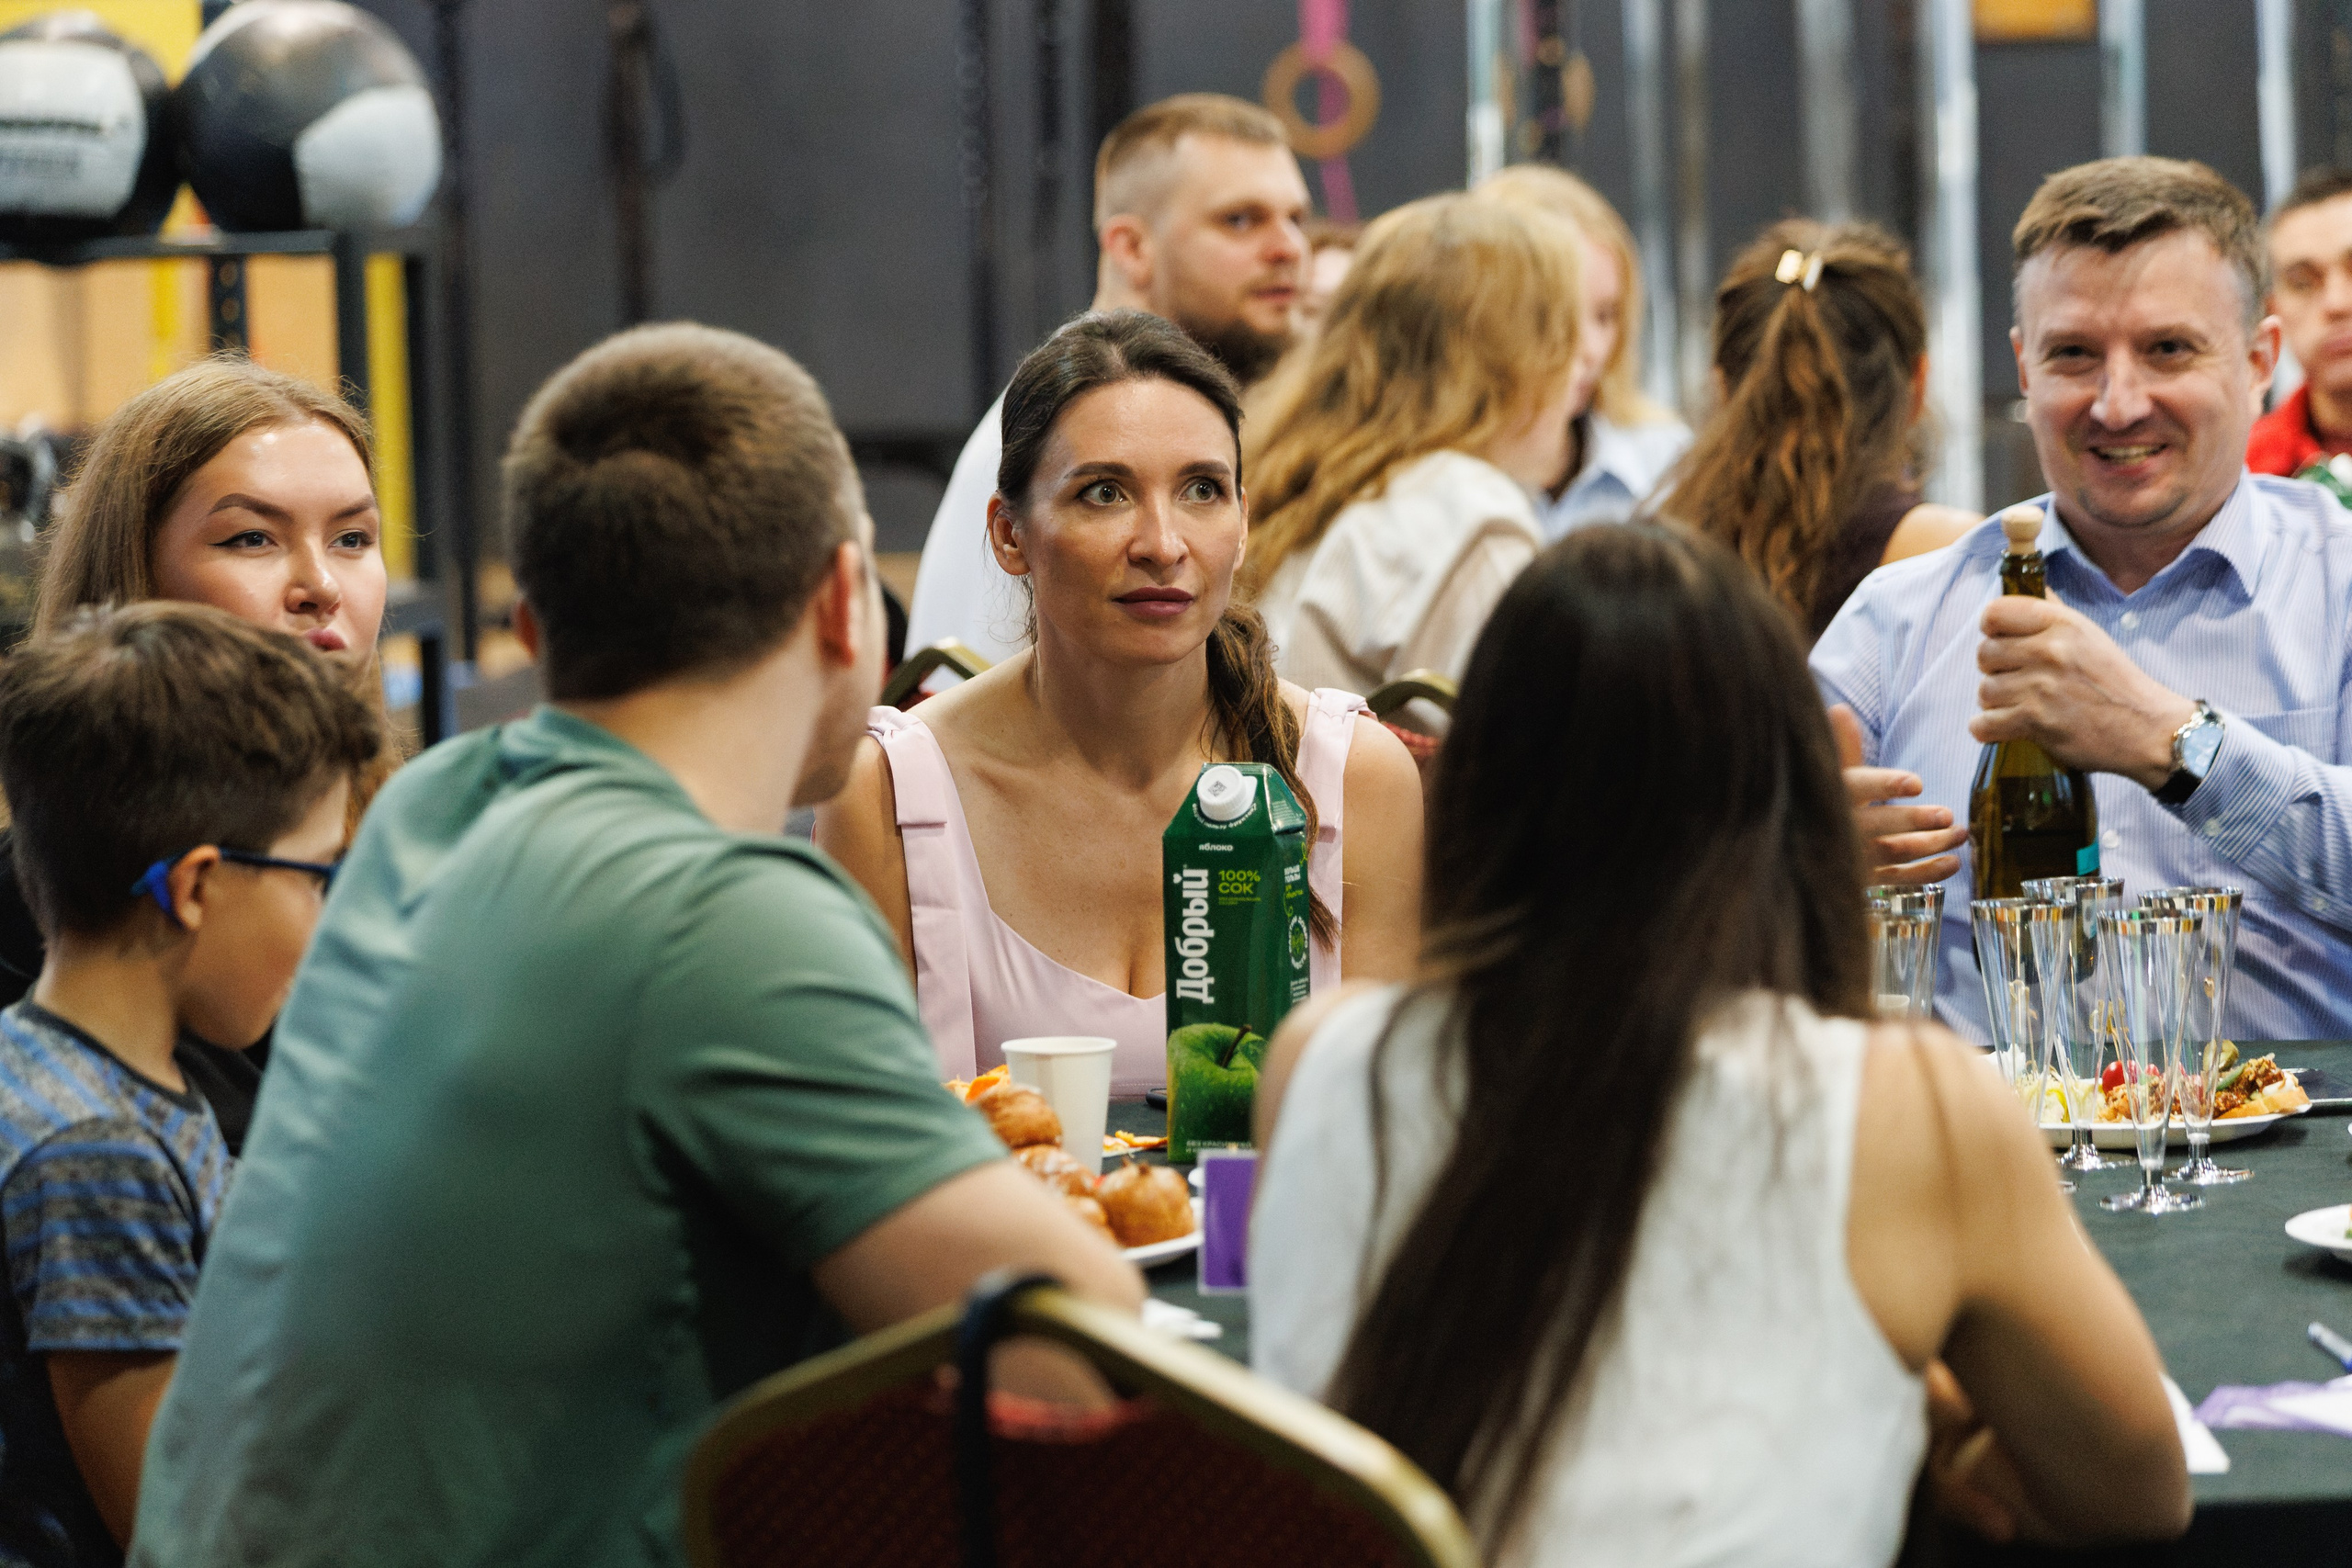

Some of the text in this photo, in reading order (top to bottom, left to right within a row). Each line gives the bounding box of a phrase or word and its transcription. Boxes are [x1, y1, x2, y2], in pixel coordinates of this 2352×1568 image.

[1198, 842, 1234, 852] яблоко
[1218, 870, 1261, 882] 100%
[1218, 882, 1254, 895] СОК
[1173, 868, 1216, 1004] Добрый
